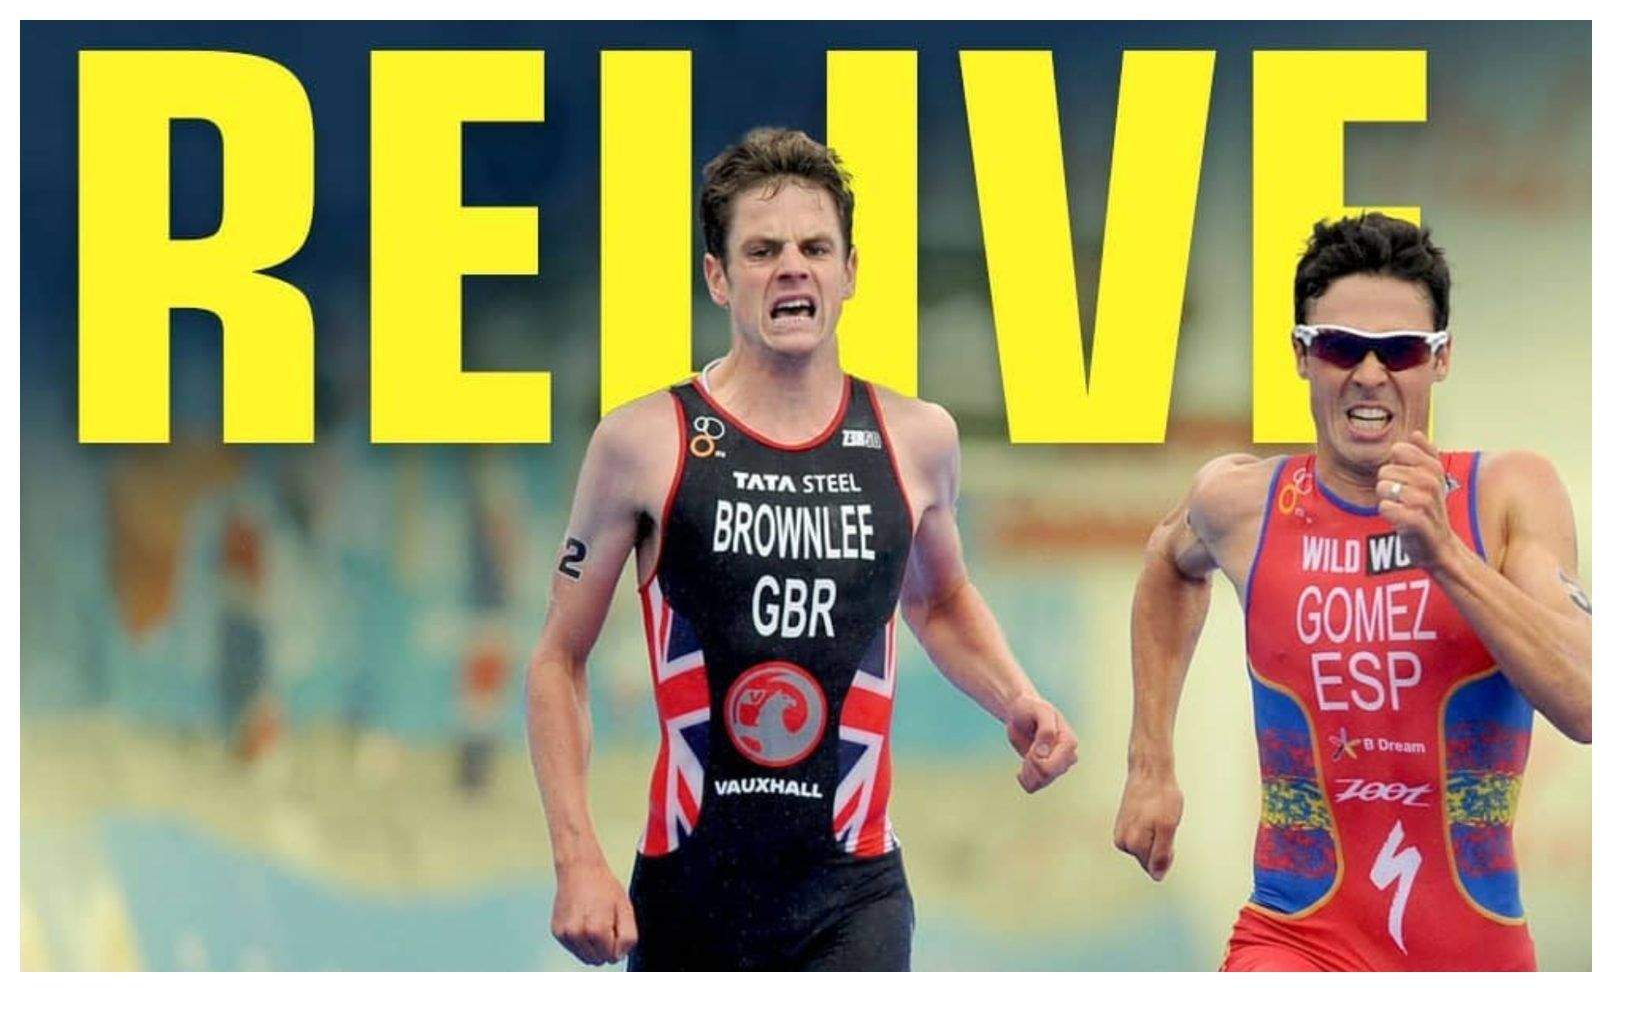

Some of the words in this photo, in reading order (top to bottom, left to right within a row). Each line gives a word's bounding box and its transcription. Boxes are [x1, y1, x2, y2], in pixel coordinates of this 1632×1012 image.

[732, 470, 797, 493] TATA
[802, 472, 862, 493] STEEL
[713, 499, 875, 560] BROWNLEE
[559, 537, 587, 579] 2
[1302, 535, 1361, 573] WILD
[752, 574, 837, 638] GBR
[1296, 578, 1437, 645] GOMEZ
[1311, 650, 1422, 711] ESP
[1363, 737, 1375, 752] B
[1377, 738, 1426, 753] Dream
[714, 777, 823, 799] VAUXHALL
